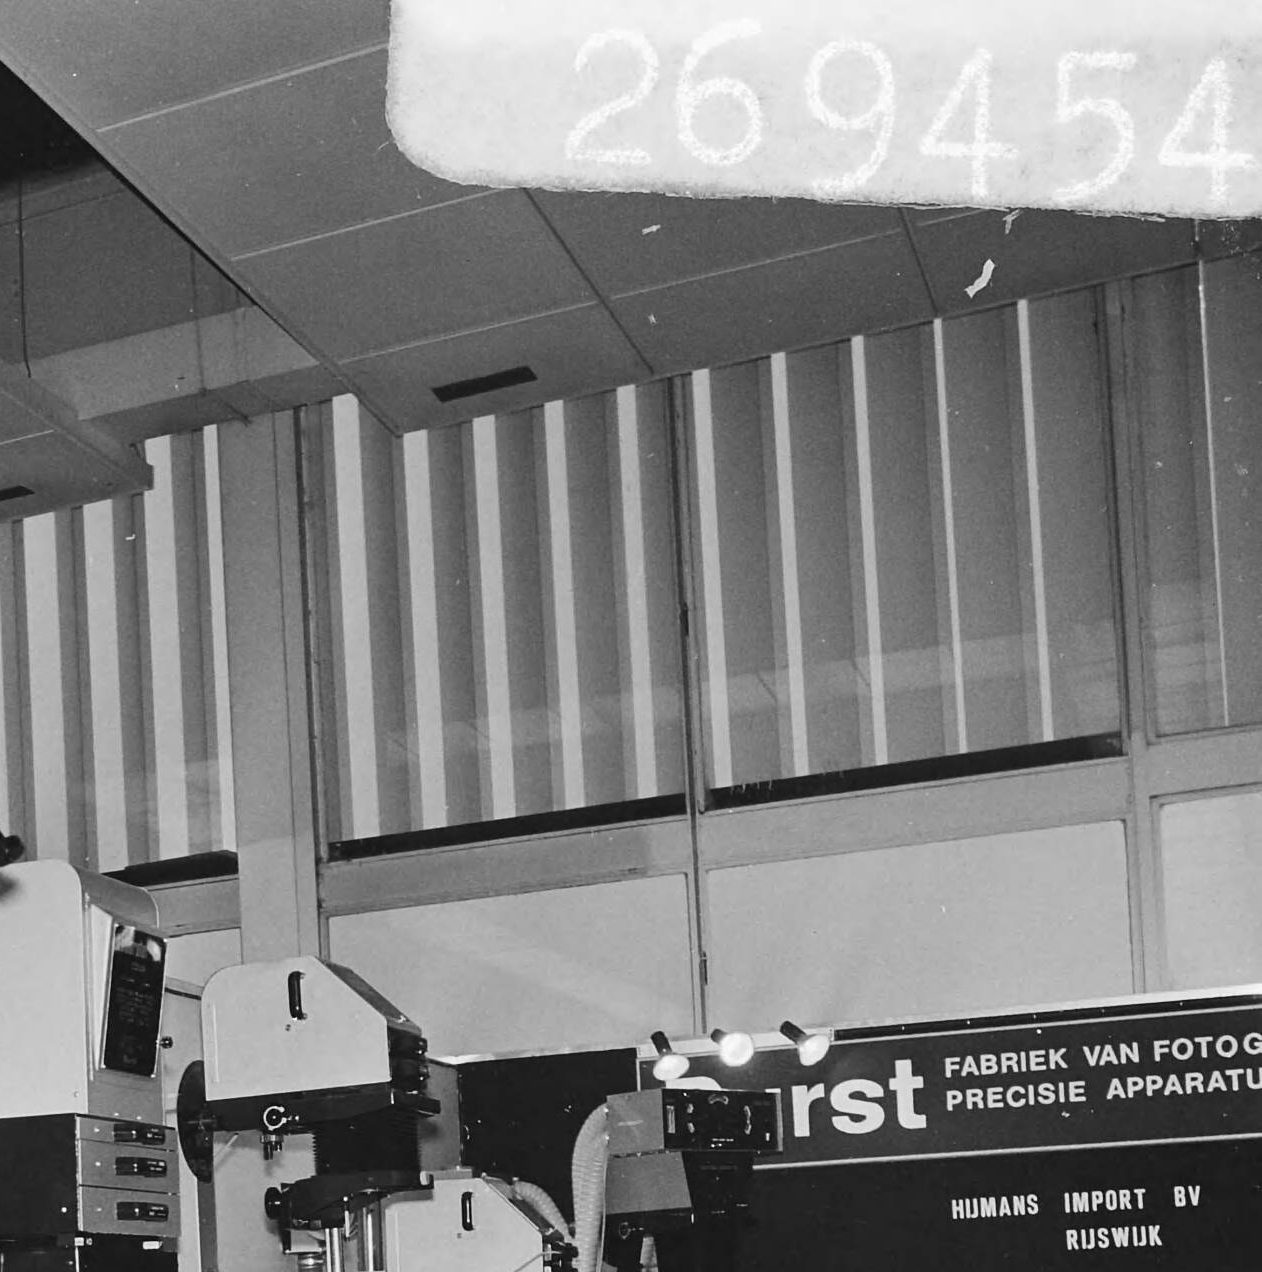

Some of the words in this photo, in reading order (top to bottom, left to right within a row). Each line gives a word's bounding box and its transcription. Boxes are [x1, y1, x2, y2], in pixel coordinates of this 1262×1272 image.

[944, 1048, 1068, 1078] FABRIEK
[1082, 1042, 1140, 1067] VAN
[1153, 1032, 1262, 1062] FOTOG
[946, 1081, 1087, 1111] PRECISIE
[1106, 1067, 1262, 1100] APPARATU
[951, 1194, 1039, 1220] HIJMANS
[1064, 1188, 1146, 1213] IMPORT
[1173, 1185, 1201, 1207] BV
[1066, 1225, 1163, 1250] RIJSWIJK
